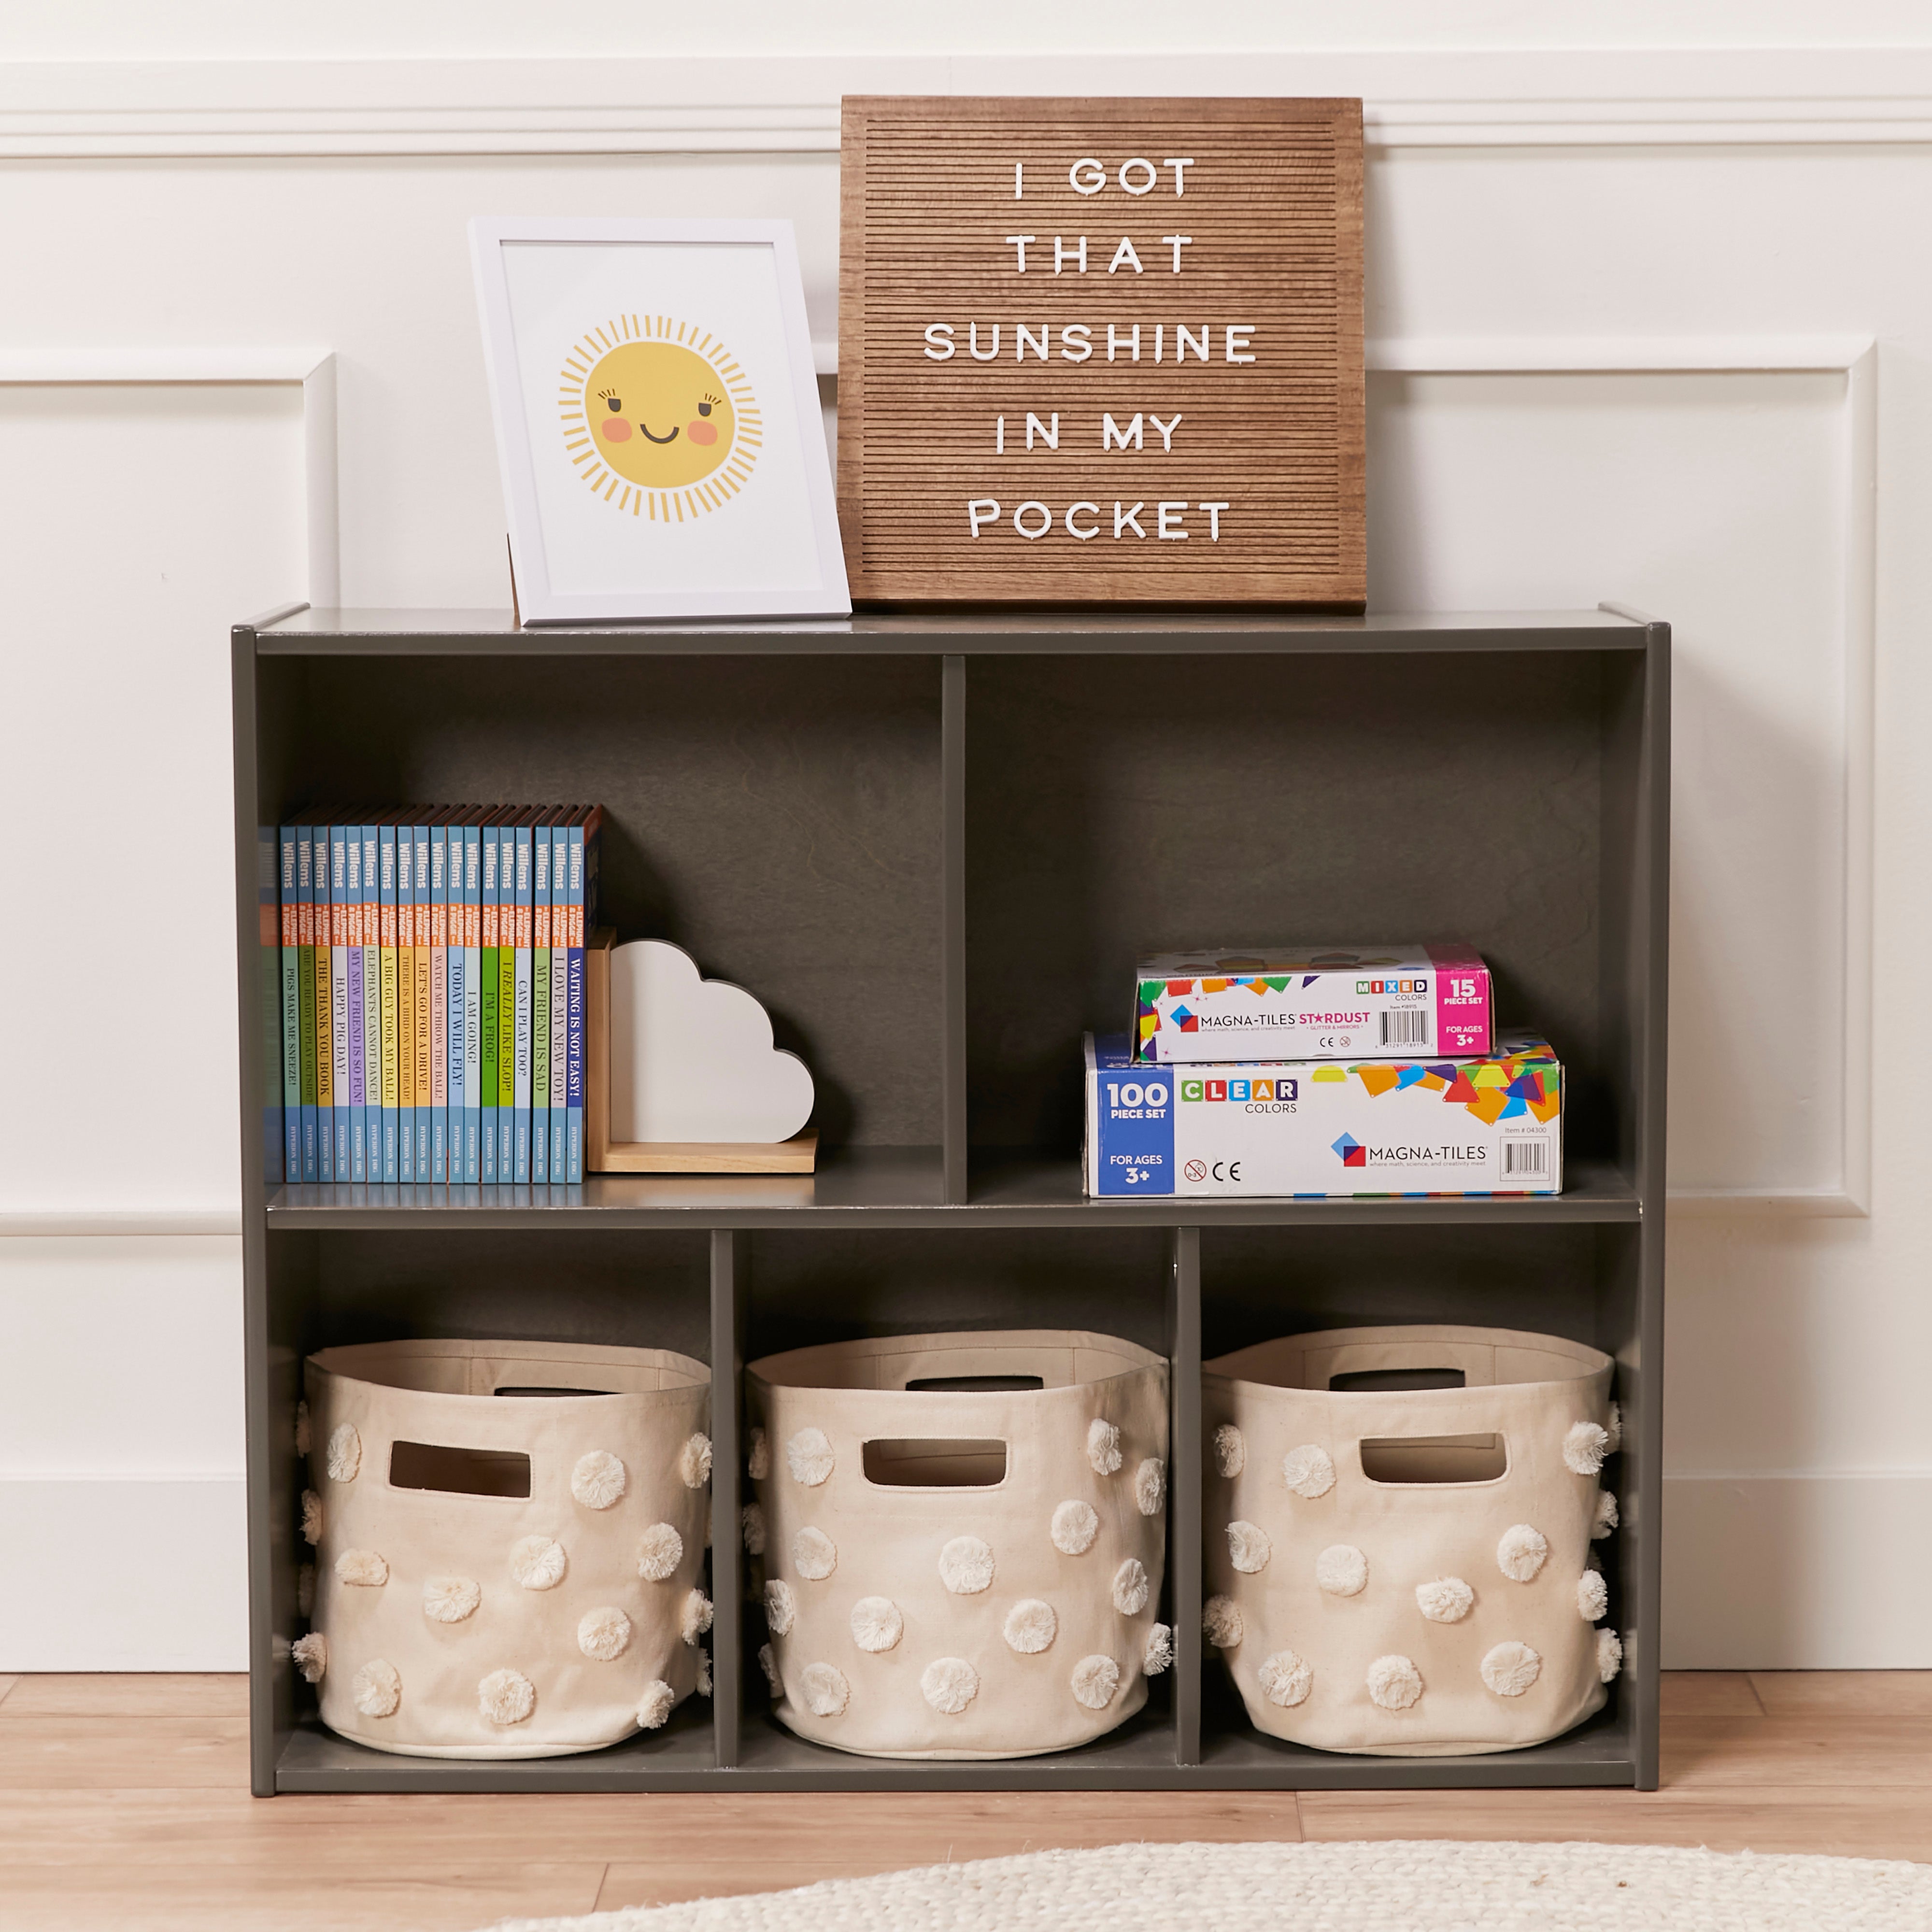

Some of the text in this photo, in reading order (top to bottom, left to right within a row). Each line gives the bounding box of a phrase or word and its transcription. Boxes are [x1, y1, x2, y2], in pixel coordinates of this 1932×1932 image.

[1015, 157, 1194, 199] I GOT
[1006, 234, 1193, 276] THAT
[923, 321, 1256, 364] SUNSHINE
[996, 412, 1182, 454] IN MY
[967, 499, 1230, 541] POCKET
[284, 842, 294, 888] Willems
[299, 841, 310, 887] Willems
[315, 843, 327, 889] Willems
[334, 842, 345, 888] Willems
[349, 843, 360, 889] Willems
[365, 840, 376, 887] Willems
[383, 843, 393, 889] Willems
[400, 843, 411, 889] Willems
[417, 842, 428, 888] Willems
[433, 842, 443, 888] Willems
[451, 842, 462, 888] Willems
[467, 843, 478, 889] Willems
[485, 843, 496, 889] Willems
[502, 842, 513, 889] Willems
[518, 844, 529, 890] Willems
[537, 844, 548, 890] Willems
[555, 843, 566, 889] Willems
[571, 843, 581, 889] Willems
[385, 966, 393, 984] BIG
[402, 988, 410, 996] IS
[419, 963, 427, 994] LET'S
[453, 963, 462, 1006] TODAY
[518, 980, 527, 1004] CAN
[554, 966, 565, 1002] LOVE
[1357, 980, 1426, 993] MIXED
[1450, 979, 1476, 997] 15
[385, 988, 393, 1009] GUY
[419, 997, 427, 1012] GO
[435, 993, 442, 1007] ME
[468, 999, 476, 1017] AM
[503, 970, 512, 1021] REALLY
[288, 1026, 296, 1040] ME
[305, 1022, 312, 1033] TO
[318, 958, 329, 1095] THE THANK YOU BOOK
[336, 978, 346, 1074] HAPPY PIG DAY!
[352, 951, 362, 1102] MY NEW FRIEND IS SO FUN!
[367, 950, 377, 1100] ELEPHANTS CANNOT DANCE!
[419, 1016, 427, 1037] FOR
[485, 992, 495, 1063] I'M A FROG!
[518, 1015, 527, 1044] PLAY
[536, 965, 547, 1091] MY FRIEND IS SAD
[554, 1008, 564, 1027] MY
[570, 958, 581, 1096] WAITING IS NOT EASY!
[1201, 1014, 1296, 1026] MAGNA-TILES
[403, 1032, 410, 1043] ON
[453, 1020, 462, 1054] WILL
[468, 1022, 476, 1063] GOING!
[502, 1024, 511, 1053] LIKE
[554, 1033, 564, 1065] NEW
[1456, 1035, 1474, 1046] 3+
[385, 1048, 394, 1064] MY
[419, 1052, 427, 1090] DRIVE!
[453, 1058, 462, 1085] FLY!
[502, 1056, 511, 1091] SLOP!
[518, 1047, 527, 1076] TOO?
[385, 1068, 394, 1100] BALL!
[554, 1069, 563, 1101] TOY!
[1107, 1082, 1168, 1108] 100
[1184, 1081, 1294, 1099] CLEAR
[1111, 1109, 1166, 1119] PIECE SET
[1245, 1104, 1297, 1114] COLORS
[1110, 1155, 1163, 1165] FOR AGES
[1370, 1146, 1486, 1160] MAGNA-TILES
[1125, 1167, 1150, 1184] 3+
